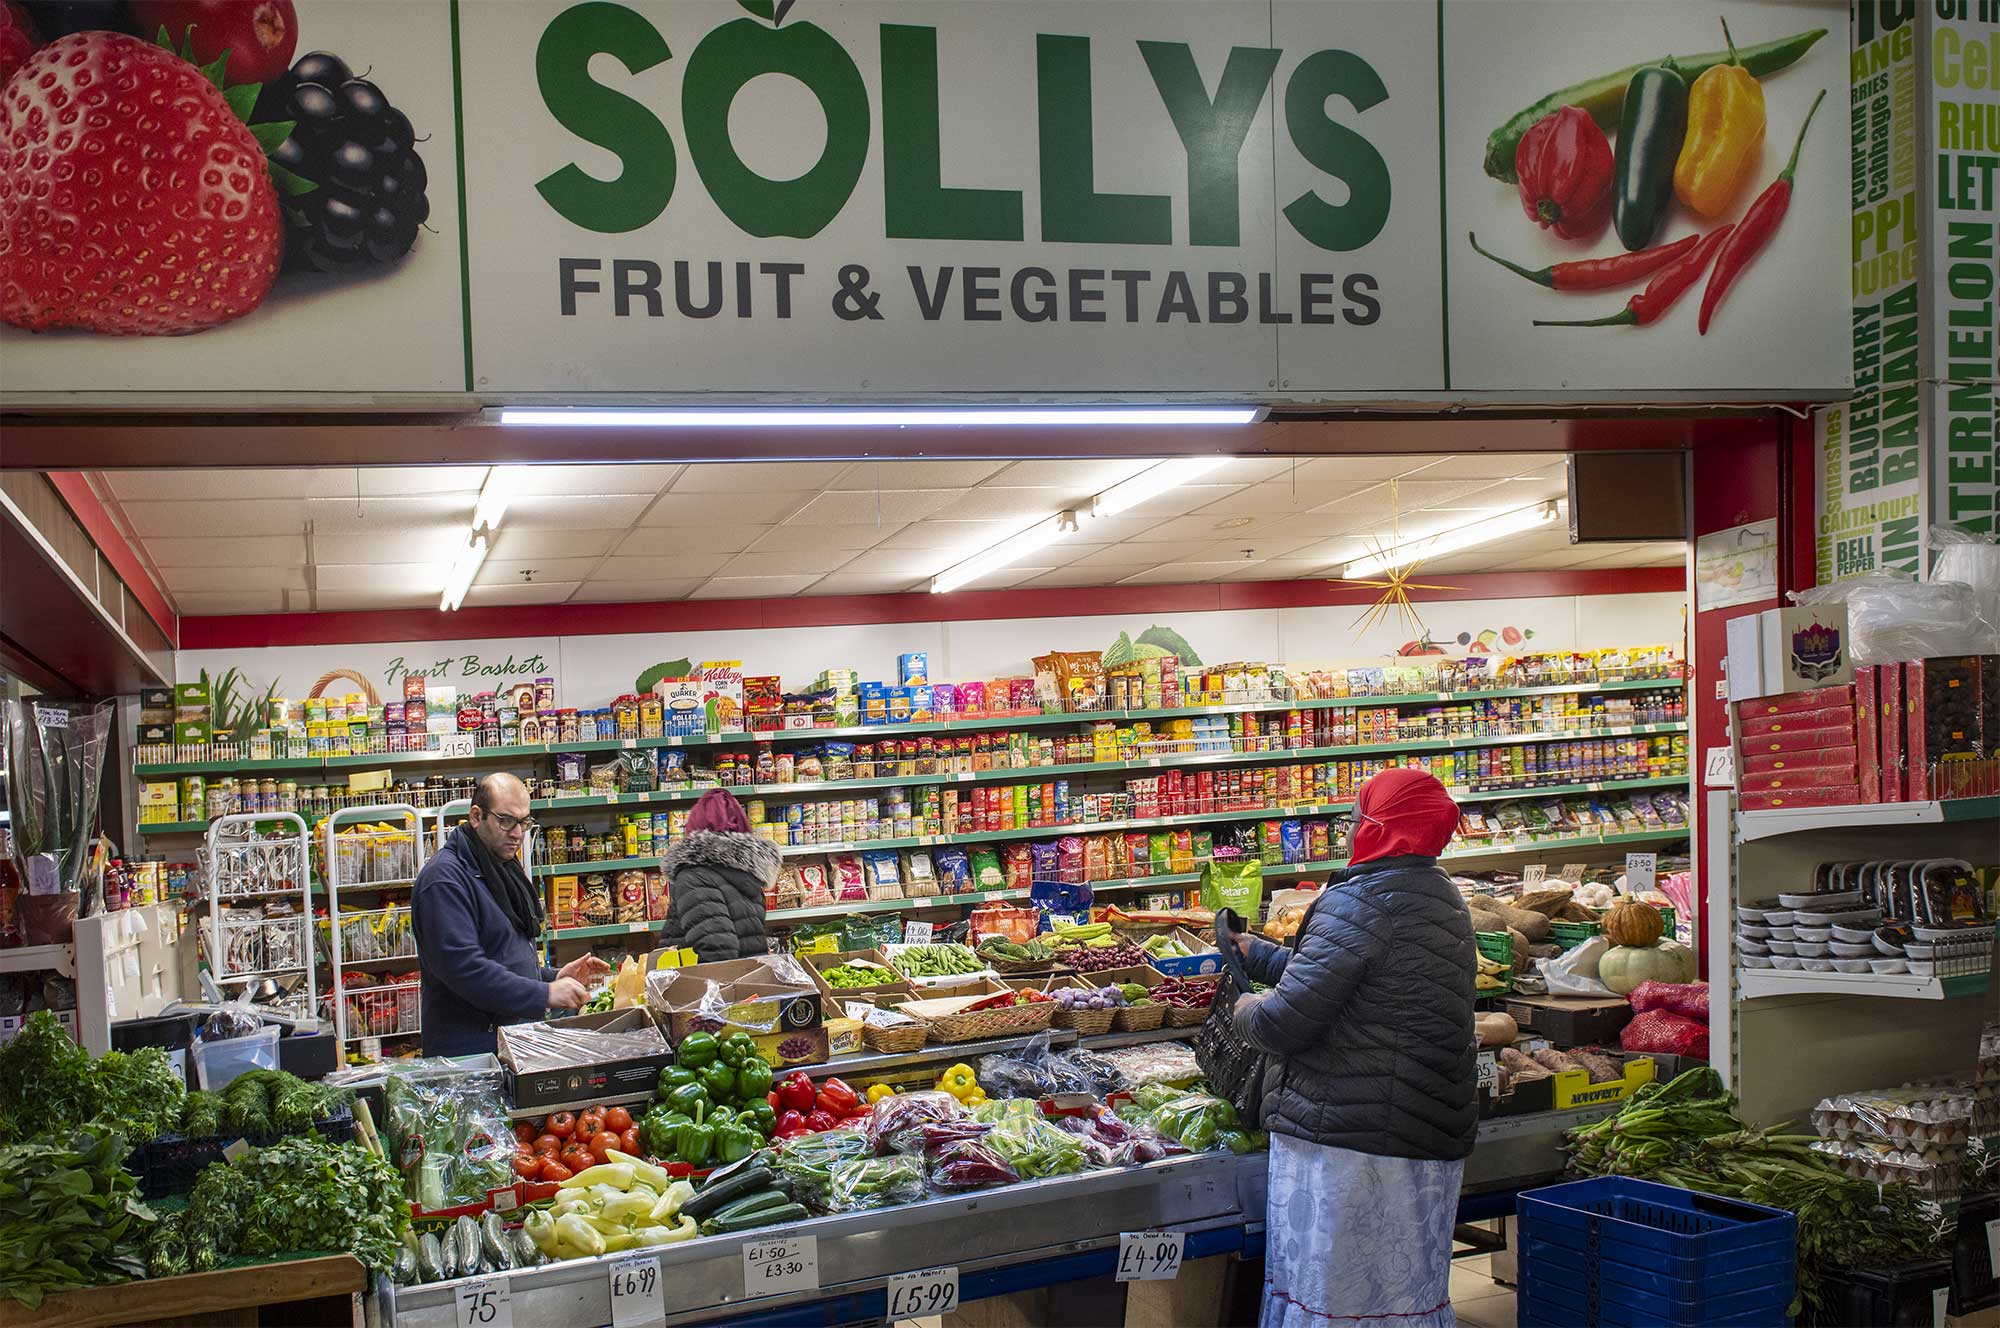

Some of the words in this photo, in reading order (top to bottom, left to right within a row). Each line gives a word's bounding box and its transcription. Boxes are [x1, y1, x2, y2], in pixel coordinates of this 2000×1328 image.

[534, 0, 1391, 251] SOLLYS
[1868, 94, 1890, 203] Cabbage
[559, 258, 804, 318] FRUIT
[832, 264, 884, 320] &
[907, 266, 1381, 325] VEGETABLES
[1850, 304, 1880, 494] BLUEBERRY
[1882, 282, 1919, 486] BANANA
[1826, 409, 1842, 514] squashes
[1817, 535, 1833, 586] CORN
[1837, 536, 1875, 563] BELL
[1837, 557, 1875, 576] PEPPER
[384, 656, 454, 685] Fruit
[460, 654, 548, 677] Baskets
[671, 690, 697, 698] QUAKER
[1221, 886, 1249, 896] Setara
[749, 1247, 786, 1260] £1.50
[1121, 1242, 1178, 1273] £4.99
[612, 1267, 656, 1296] £6.99
[766, 1262, 803, 1278] £3.30
[463, 1291, 496, 1324] 75
[891, 1282, 955, 1316] £5.99
